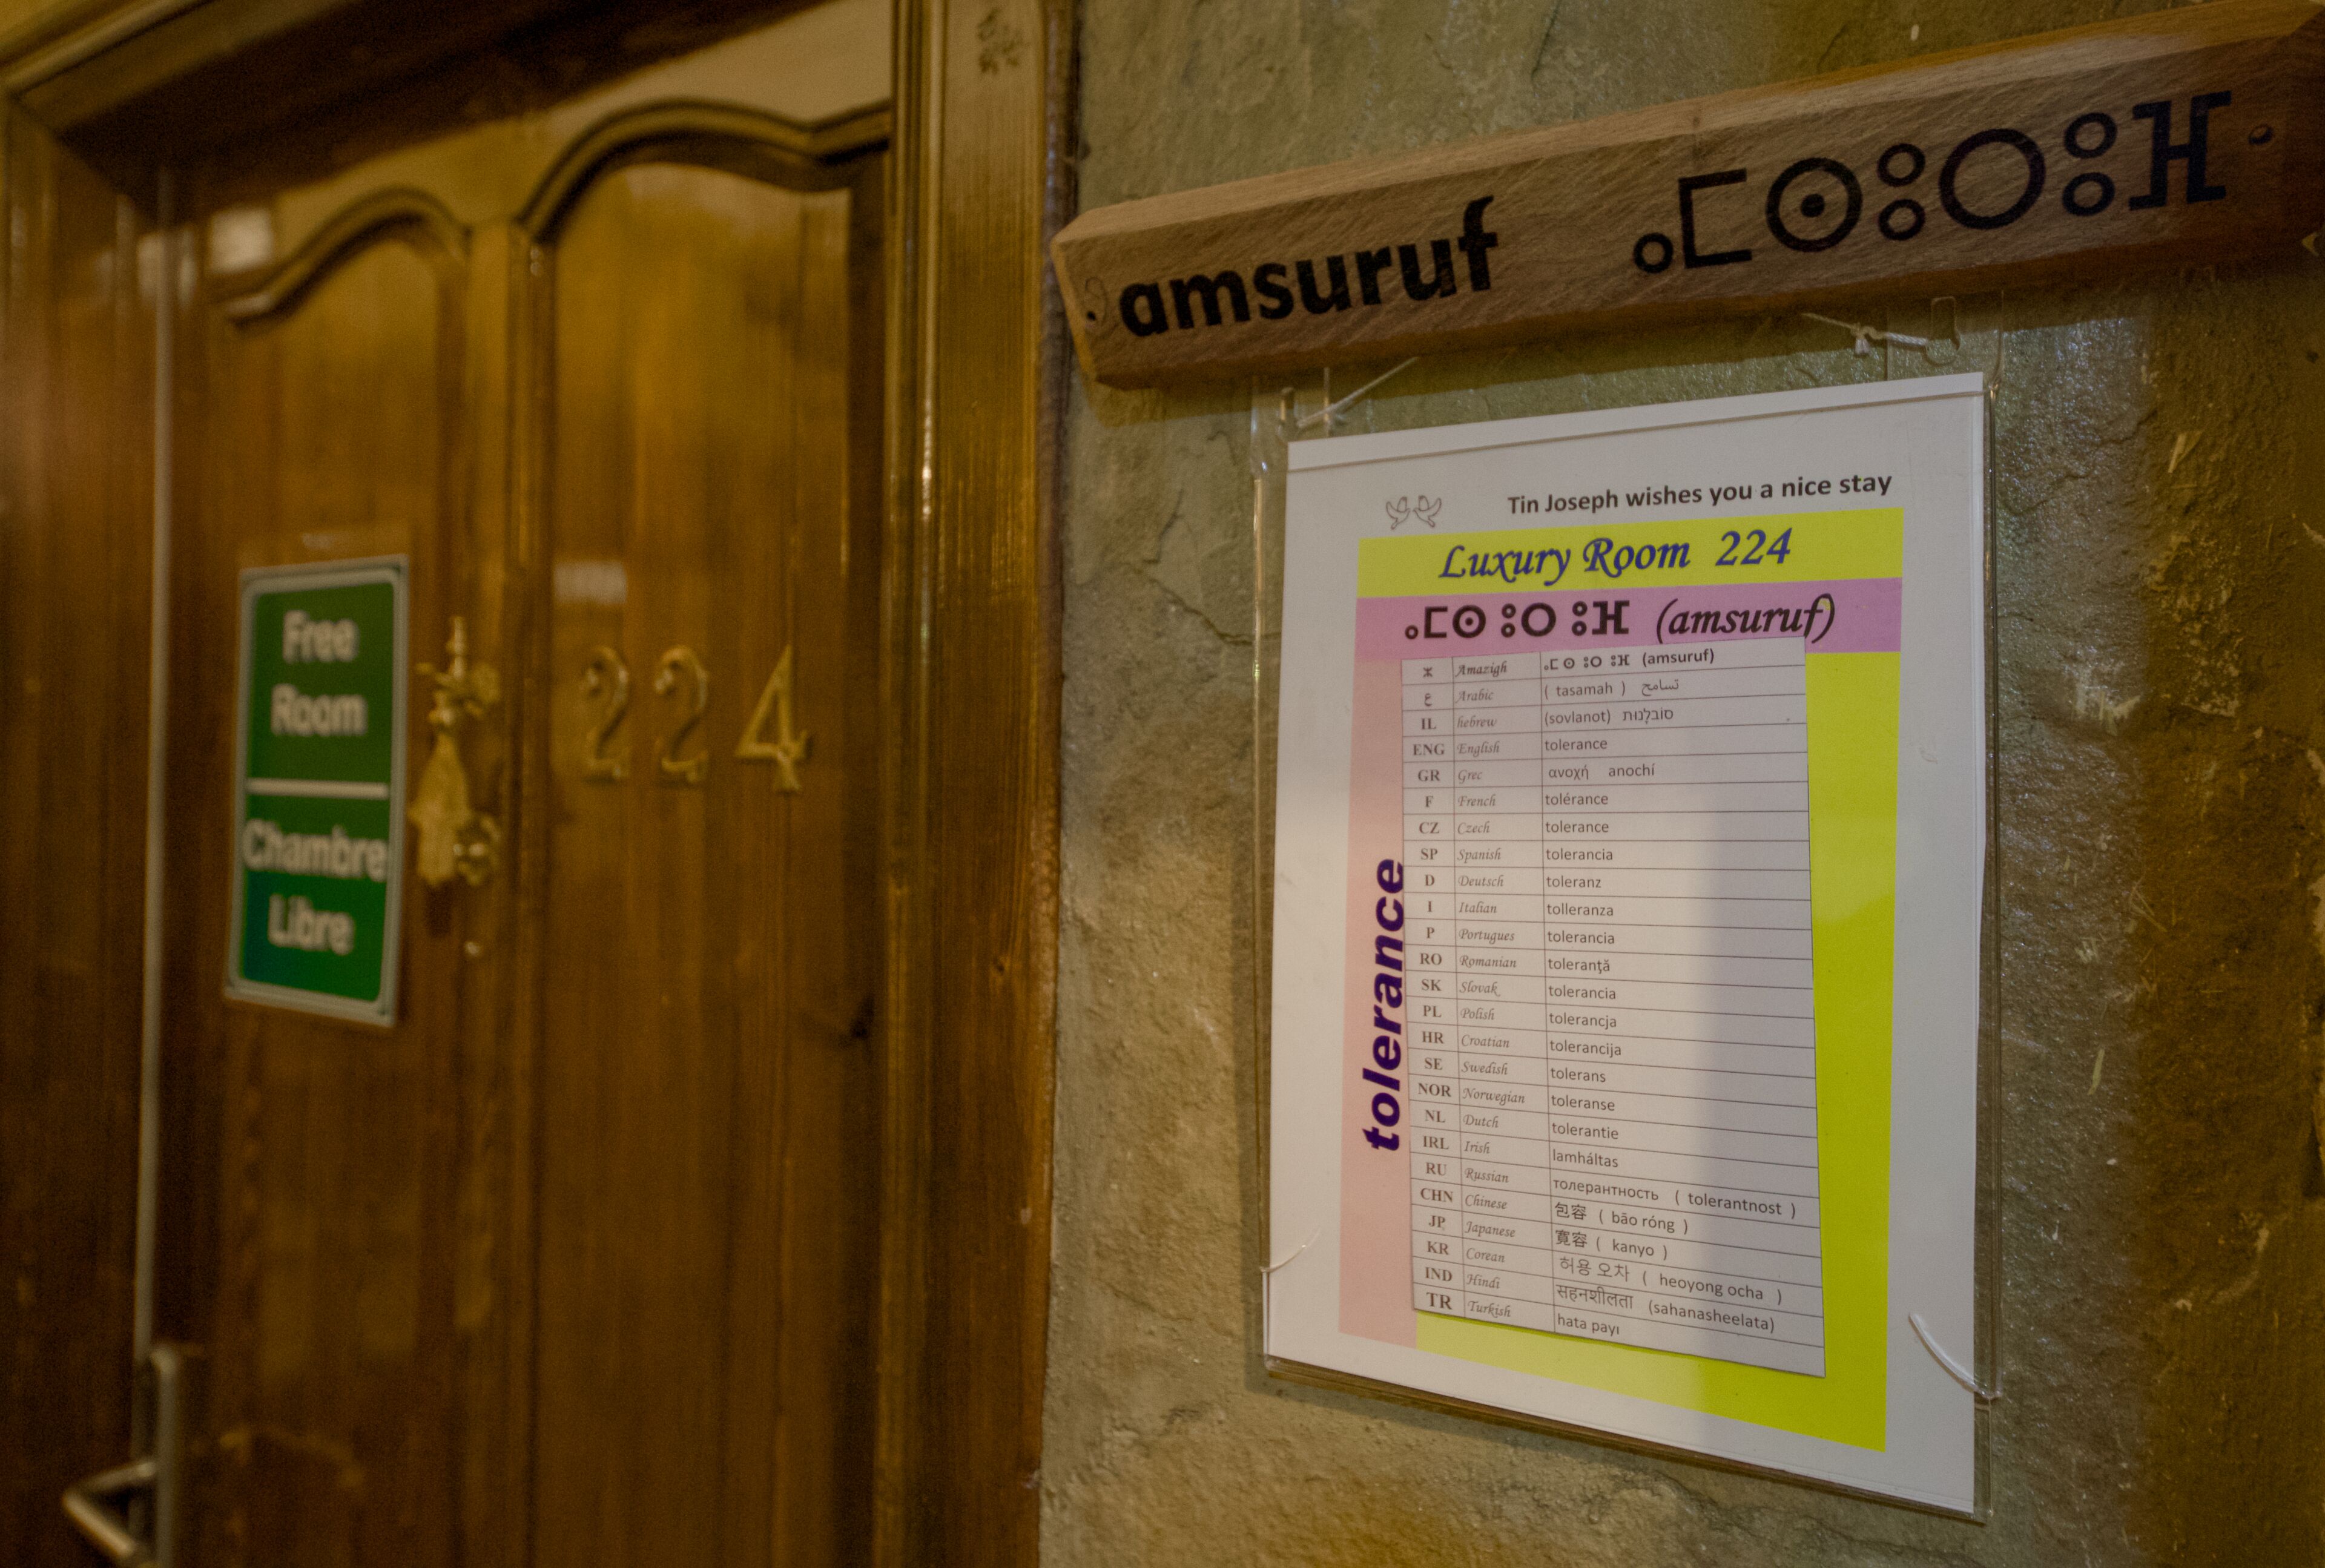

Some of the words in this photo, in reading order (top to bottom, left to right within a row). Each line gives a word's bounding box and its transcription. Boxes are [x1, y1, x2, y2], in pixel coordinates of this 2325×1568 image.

[1120, 196, 1499, 336] amsuruf
[1508, 495, 1538, 514] Tin
[1545, 489, 1618, 513] Joseph
[1626, 486, 1702, 507] wishes
[1709, 486, 1752, 506] you
[1761, 484, 1773, 498] a
[1782, 476, 1831, 497] nice
[1840, 475, 1892, 496] stay
[1438, 545, 1571, 587] Luxury
[1583, 538, 1690, 578] Room
[1715, 527, 1792, 566] 224
[1657, 594, 1835, 645] (amsuruf)
[283, 609, 360, 664] Free
[1456, 660, 1507, 677] Amazigh
[1643, 648, 1714, 667] (amsuruf)
[1456, 688, 1494, 703] Arabic
[1556, 682, 1612, 696] tasamah
[1641, 679, 1679, 697] تسامح
[271, 683, 368, 736] Room
[1422, 718, 1436, 730] IL
[1457, 715, 1497, 728] hebrew
[1545, 709, 1611, 725] (sovlanot)
[1413, 743, 1445, 756] ENG
[1457, 740, 1500, 757] English
[1545, 739, 1608, 751] tolerance
[1417, 769, 1440, 782] GR
[1457, 769, 1482, 782] Grec
[1548, 765, 1589, 780] ανοχή
[1609, 763, 1655, 777] anochí
[1425, 796, 1434, 808] F
[1458, 794, 1496, 806] French
[1545, 792, 1608, 805] tolérance
[1419, 822, 1439, 834] CZ
[1457, 821, 1489, 834] Czech
[1545, 820, 1609, 833] tolerance
[243, 819, 388, 882] Chambre
[1421, 848, 1438, 860] SP
[1457, 848, 1501, 862] Spanish
[1546, 848, 1613, 860] tolerancia
[1425, 874, 1435, 886] D
[1458, 874, 1504, 887] Deutsch
[1546, 875, 1601, 888] toleranz
[1428, 900, 1433, 913] I
[1459, 901, 1497, 914] Italian
[1547, 903, 1614, 917] tolleranza
[268, 893, 354, 955] Libre
[1426, 927, 1435, 939] P
[1459, 929, 1515, 944] Portugues
[1548, 930, 1615, 944] tolerancia
[1420, 953, 1442, 965] RO
[1460, 955, 1517, 968] Romanian
[1422, 979, 1442, 991] SK
[1459, 980, 1500, 997] Slovak
[1548, 985, 1616, 1000] tolerancia
[1362, 859, 1405, 1151] tolerance
[1423, 1005, 1442, 1018] PL
[1460, 1007, 1494, 1020] Polish
[1549, 1012, 1617, 1030] tolerancja
[1422, 1031, 1444, 1044] HR
[1461, 1035, 1509, 1048] Croatian
[1549, 1039, 1621, 1058] tolerancija
[1425, 1057, 1443, 1070] SE
[1461, 1061, 1508, 1075] Swedish
[1551, 1067, 1606, 1082] tolerans
[1419, 1082, 1451, 1097] NOR
[1462, 1088, 1525, 1106] Norwegian
[1551, 1095, 1615, 1111] toleranse
[1425, 1110, 1445, 1123] NL
[1463, 1114, 1499, 1128] Dutch
[1552, 1122, 1618, 1139] tolerantie
[1423, 1136, 1449, 1150] IRL
[1464, 1141, 1490, 1154] Irish
[1553, 1148, 1618, 1168] lamháltas
[1426, 1162, 1446, 1176] RU
[1465, 1168, 1509, 1183] Russian
[1420, 1188, 1453, 1202] CHN
[1465, 1194, 1508, 1210] Chinese
[1553, 1180, 1658, 1201] толерантность
[1555, 1202, 1586, 1220] 包容
[1688, 1193, 1782, 1215] tolerantnost
[1428, 1215, 1446, 1228] JP
[1465, 1222, 1515, 1237] Japanese
[1612, 1211, 1637, 1226] bāo
[1643, 1215, 1675, 1233] róng
[1427, 1241, 1449, 1255] KR
[1466, 1248, 1505, 1263] Corean
[1612, 1239, 1654, 1257] kanyo
[1425, 1267, 1453, 1281] IND
[1466, 1274, 1500, 1289] Hindi
[1560, 1256, 1591, 1276] 허용
[1597, 1263, 1629, 1282] 오차
[1555, 1283, 1634, 1311] सहनशीलता
[1660, 1273, 1723, 1297] heoyong
[1727, 1281, 1763, 1300] ocha
[1426, 1292, 1452, 1309] TR
[1468, 1301, 1511, 1318] Turkish
[1558, 1313, 1586, 1329] hata
[1649, 1300, 1774, 1334] (sahanasheelata)
